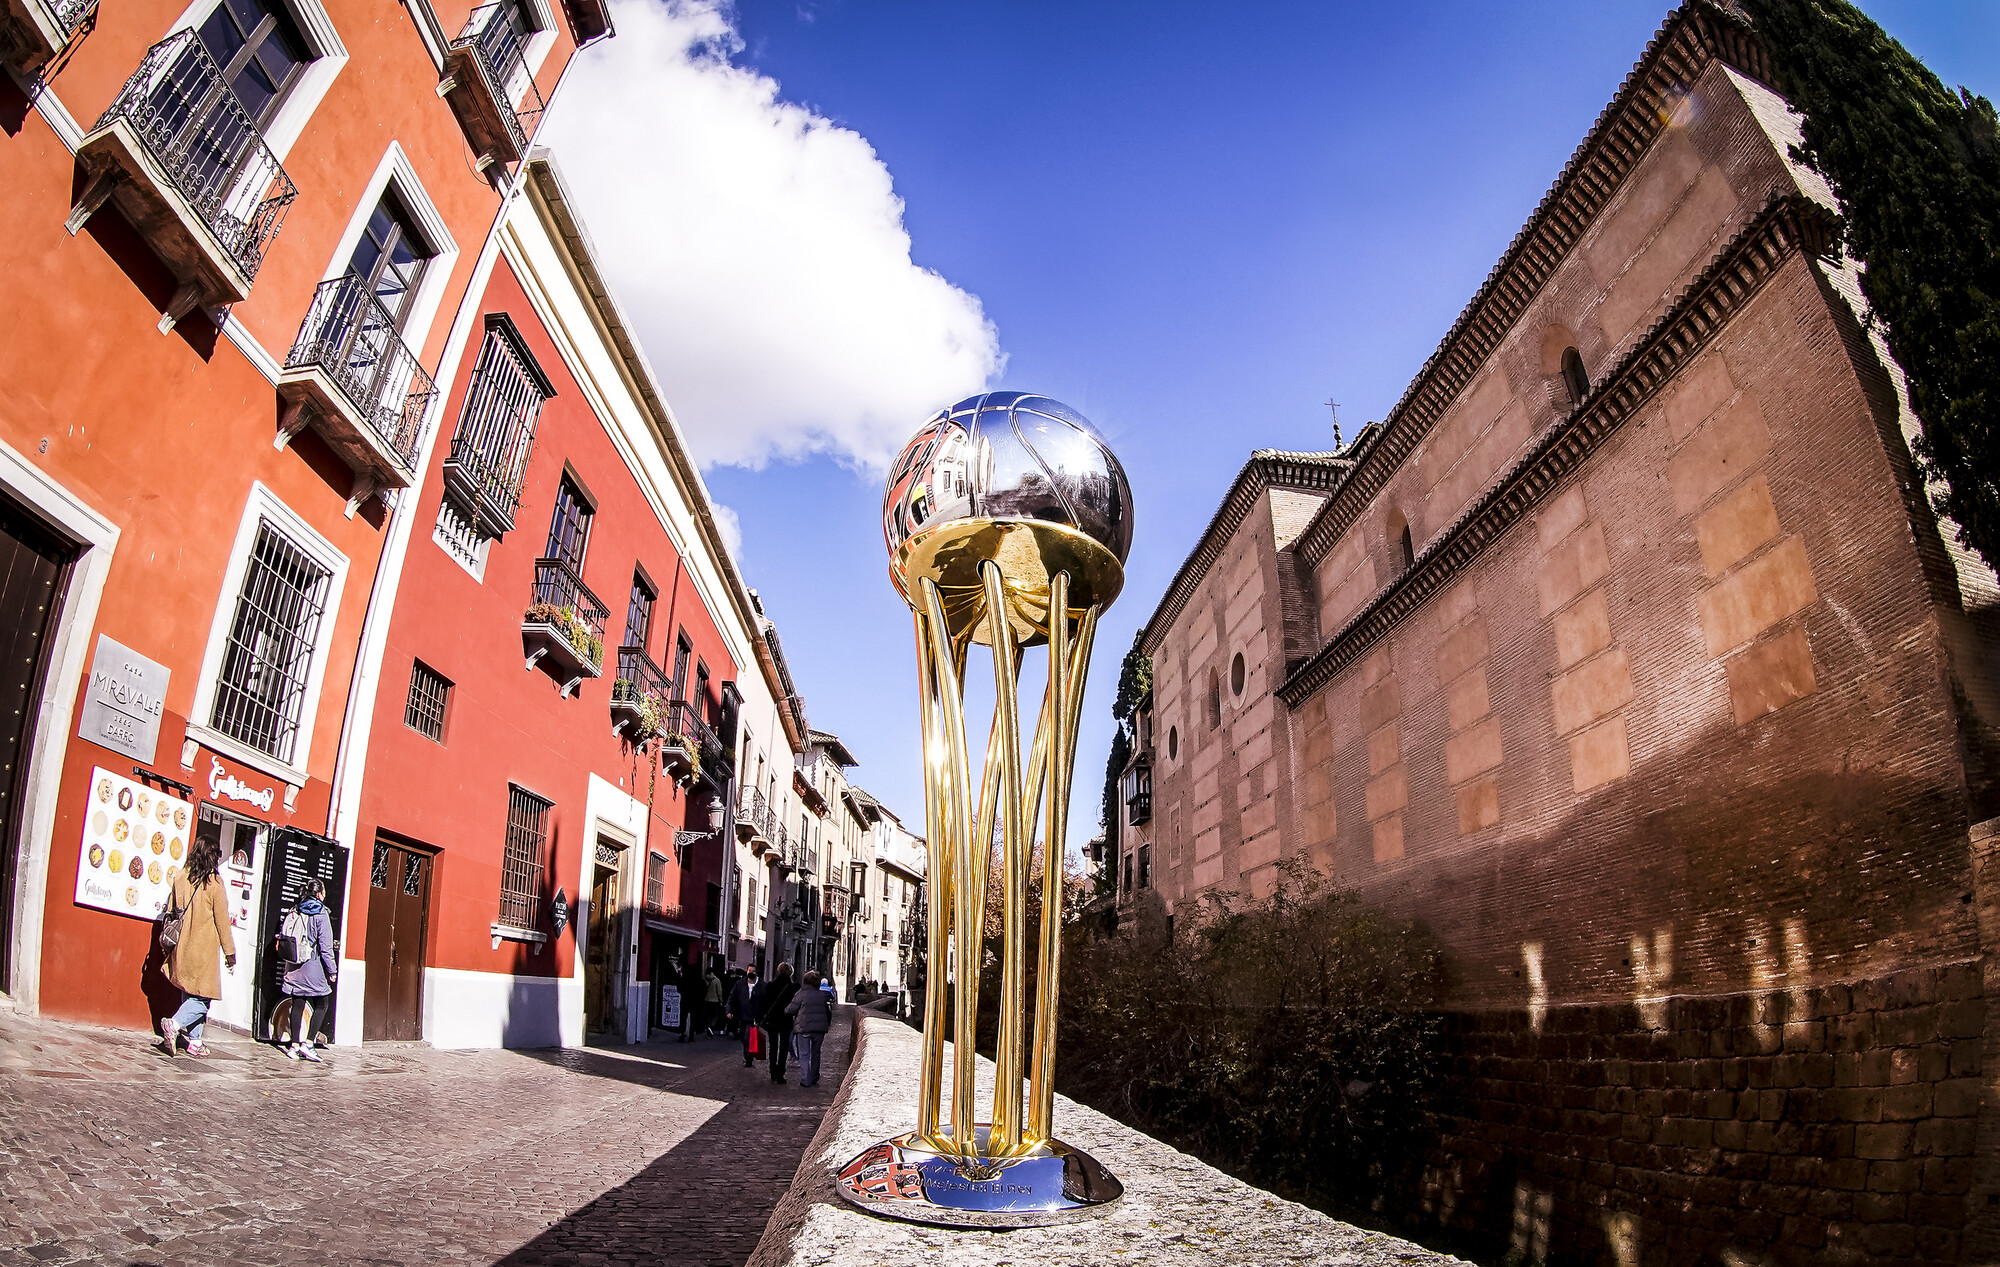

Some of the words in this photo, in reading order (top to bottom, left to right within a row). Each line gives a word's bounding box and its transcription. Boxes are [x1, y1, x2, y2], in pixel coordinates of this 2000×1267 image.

[39, 437, 48, 454] 3
[124, 662, 143, 678] CASA
[93, 671, 161, 717] MIRAVALLE
[107, 724, 135, 743] DARRO
[926, 1177, 988, 1193] Majestad
[991, 1182, 1004, 1193] El
[1006, 1184, 1032, 1195] Rey
